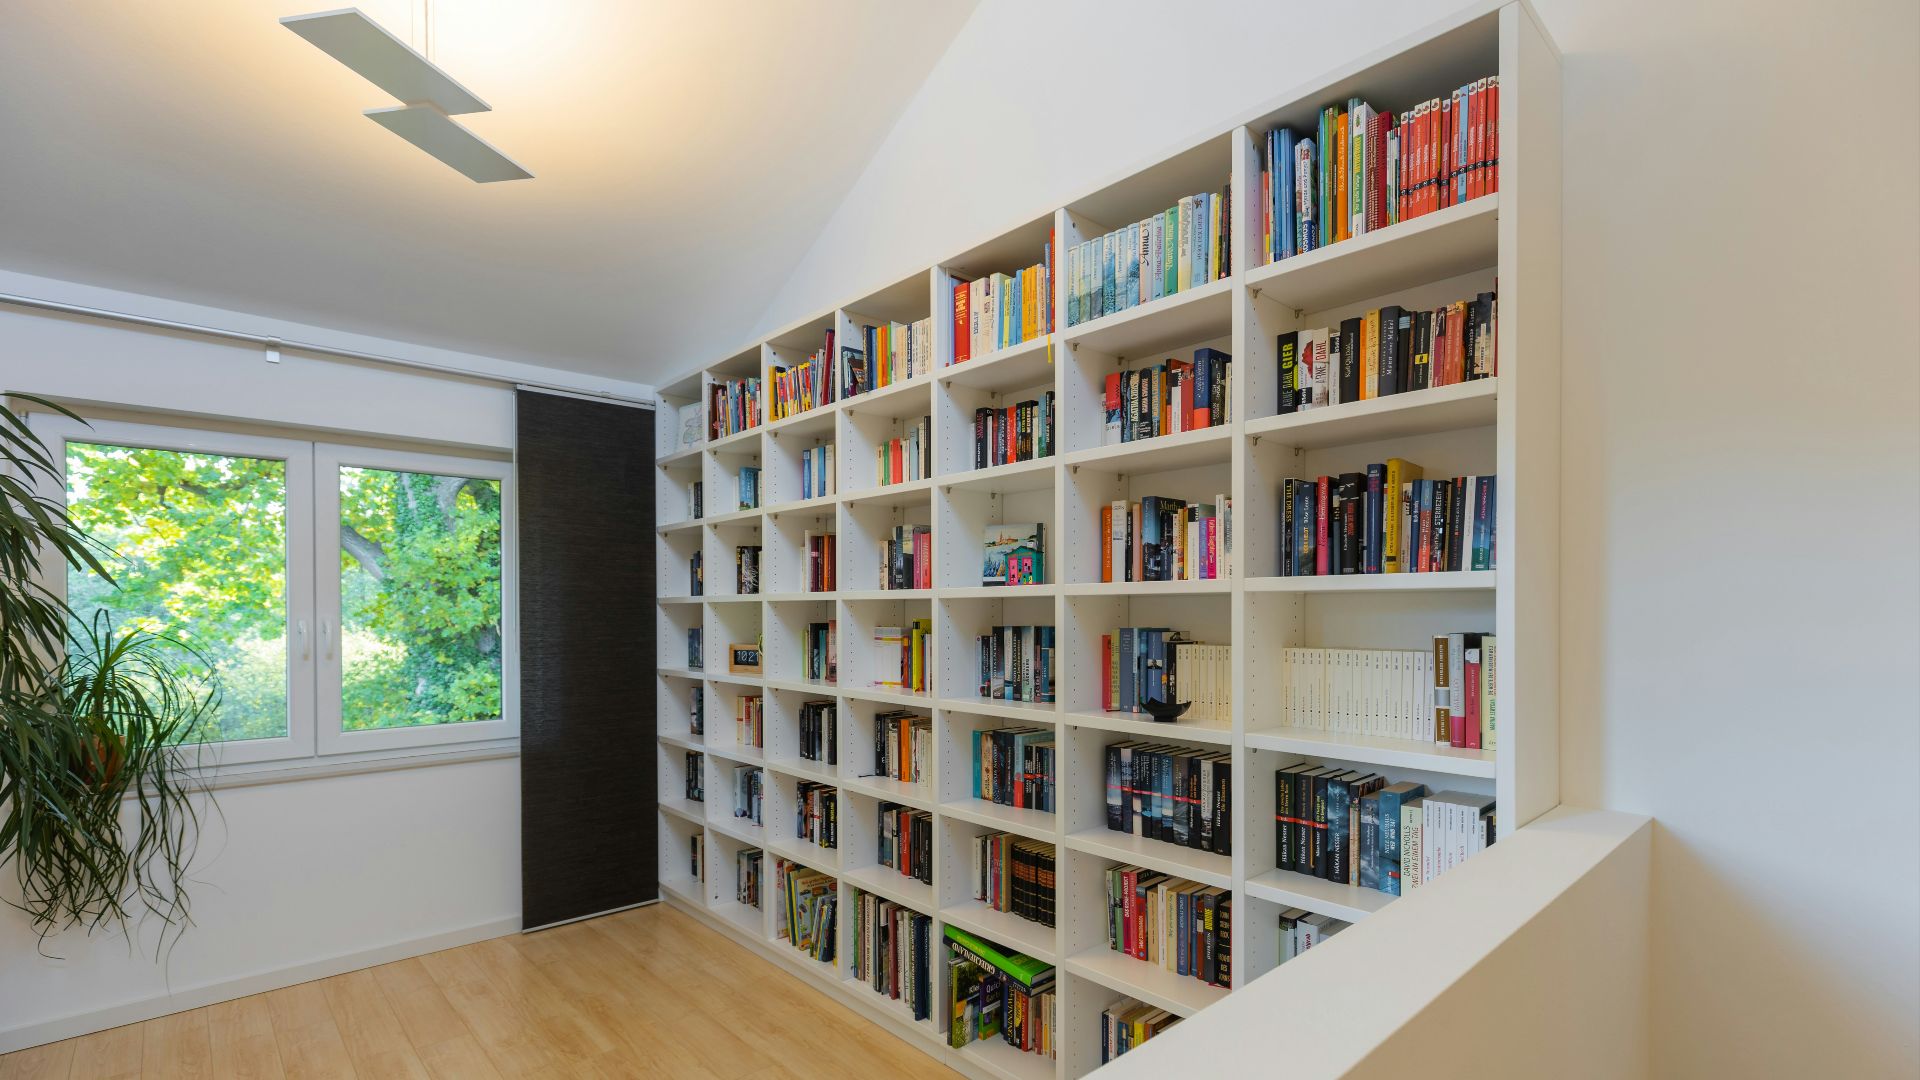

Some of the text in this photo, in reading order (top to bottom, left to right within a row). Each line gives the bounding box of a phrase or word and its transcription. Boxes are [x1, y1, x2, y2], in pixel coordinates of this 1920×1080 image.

[1140, 228, 1150, 266] Anna
[1282, 342, 1293, 407] ARNE DAHL GIER
[1315, 340, 1326, 384] ARNE DAHL
[1130, 373, 1139, 422] AGATHA CHRISTIE
[1434, 490, 1442, 526] STERBEZEIT
[1403, 825, 1411, 877] DAVID NICHOLLS
[1411, 827, 1419, 839] TAG
[1411, 841, 1419, 862] EINEM
[952, 942, 995, 975] GRIECHENLAND
